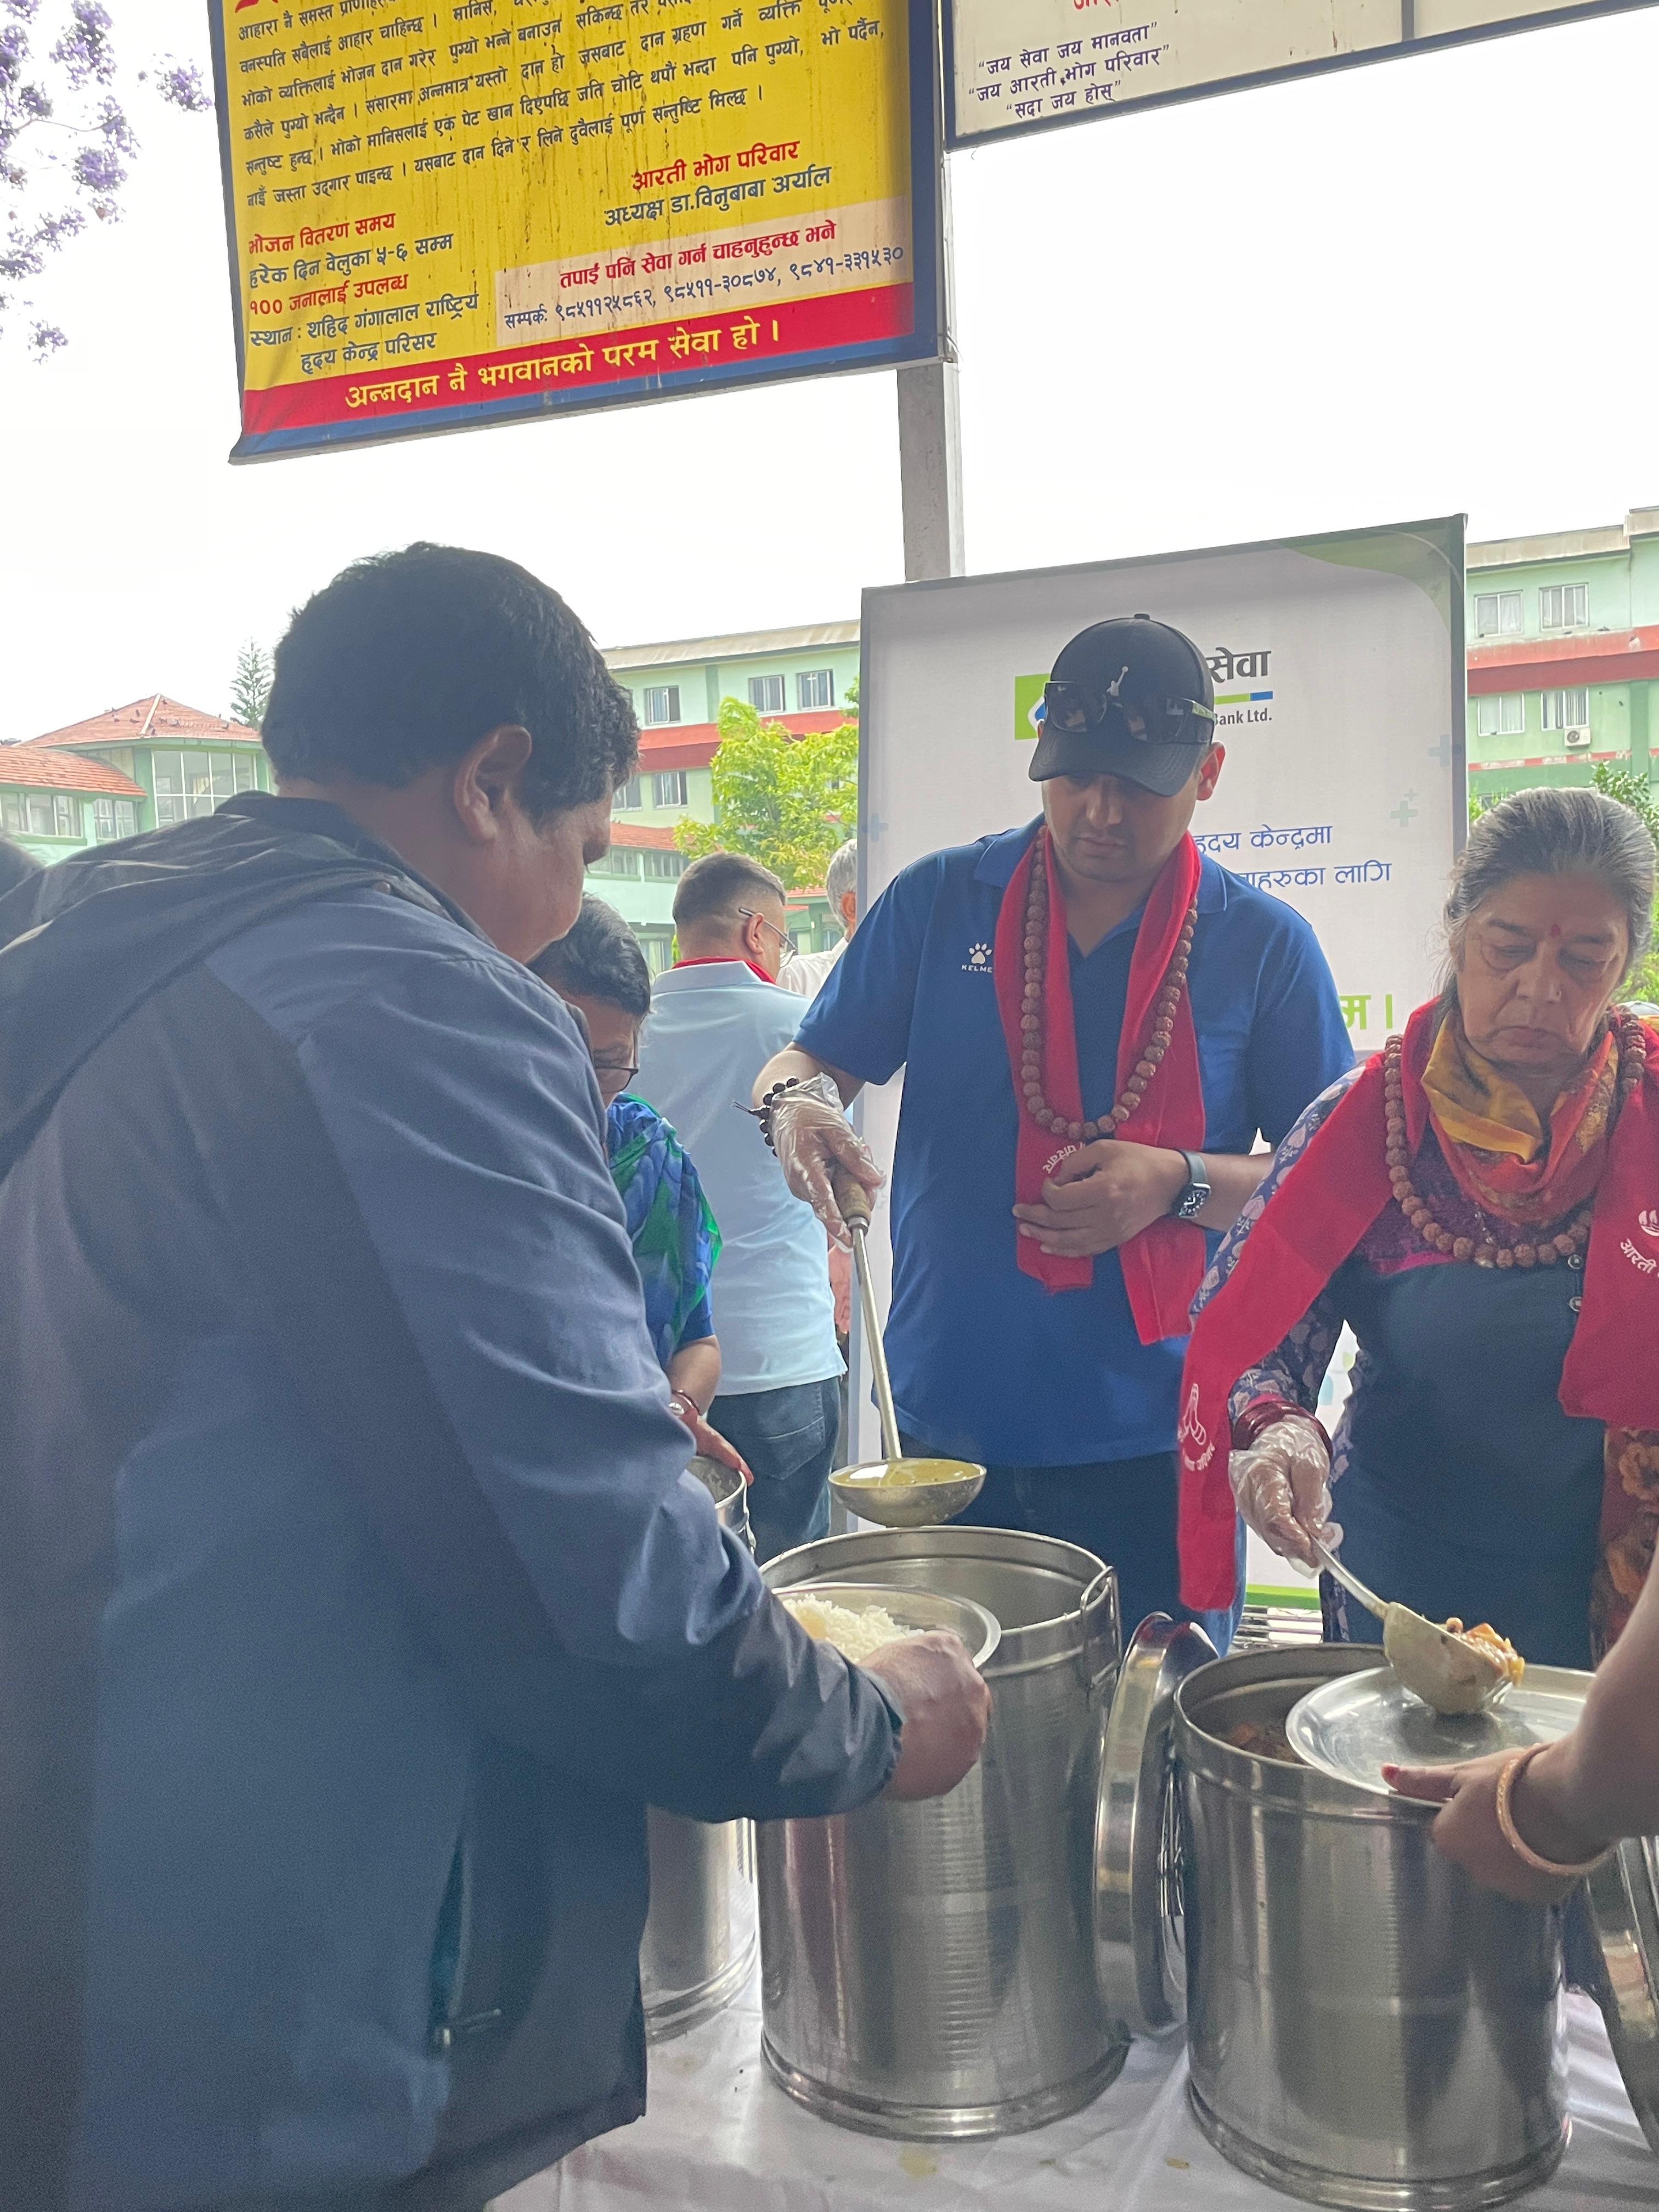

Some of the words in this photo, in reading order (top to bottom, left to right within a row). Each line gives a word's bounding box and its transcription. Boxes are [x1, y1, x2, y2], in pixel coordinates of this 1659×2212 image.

[283, 10, 293, 28] नै
[298, 4, 334, 26] समस्त
[240, 48, 286, 73] वनस्पति
[292, 35, 332, 64] सबैलाई
[338, 29, 374, 51] आहार
[379, 17, 424, 38] चाहिन्छ
[242, 86, 273, 106] भोको
[279, 70, 335, 98] व्यक्तिलाई
[341, 64, 375, 83] भोजन
[381, 58, 403, 76] दान
[409, 49, 436, 68] गरेर
[449, 37, 479, 64] पुग्यो
[485, 29, 511, 48] भन्ने
[576, 4, 623, 29] सकिन्छ
[630, 0, 649, 15] तर
[1019, 48, 1049, 69] सेवा
[1057, 40, 1083, 59] जय
[244, 119, 274, 140] कसैले
[280, 113, 308, 138] पुग्यो
[314, 103, 345, 125] भन्दैन
[475, 66, 507, 87] यस्तो
[521, 60, 545, 80] दान
[551, 52, 565, 73] हो
[640, 31, 665, 51] दान
[672, 21, 707, 44] ग्रहण
[721, 8, 743, 30] गर्ने
[1009, 67, 1056, 94] आरती
[1062, 62, 1096, 81] भोग
[246, 155, 283, 176] सन्तुष्ट
[290, 149, 313, 172] हुन्छ
[331, 135, 362, 155] भोको
[366, 118, 428, 147] मानिसलाई
[462, 110, 481, 126] पेट
[487, 103, 514, 121] खान
[576, 79, 605, 101] जति
[611, 70, 644, 92] चोटि
[683, 57, 716, 76] भन्दा
[731, 44, 759, 65] पनि
[765, 36, 804, 65] पुग्यो,
[821, 26, 840, 46] भो
[1051, 91, 1076, 110] जय
[273, 185, 306, 203] जस्ता
[356, 165, 394, 185] पाइन्छ
[414, 151, 457, 172] यसबाट
[462, 146, 486, 164] दान
[492, 137, 515, 157] दिने
[520, 136, 531, 153] र
[537, 126, 564, 147] लिने
[620, 106, 646, 133] पूर्ण
[709, 89, 748, 110] मिल्छ
[632, 160, 686, 192] आरती
[693, 154, 730, 178] भोग
[737, 140, 800, 170] परिवार
[604, 198, 664, 226] अध्यक्ष
[772, 164, 832, 193] अर्याल
[249, 234, 295, 255] भोजन
[300, 223, 349, 248] वितरण
[354, 213, 396, 235] समय
[605, 256, 636, 279] पनि
[641, 252, 673, 274] सेवा
[678, 242, 707, 266] गर्न
[712, 229, 800, 260] चाहनुहुन्छ
[805, 219, 837, 243] भने
[250, 263, 289, 289] हरेक
[294, 259, 321, 280] दिन
[414, 234, 454, 255] सम्म
[250, 298, 283, 315] १००
[289, 280, 348, 311] जनालाई
[354, 274, 409, 298] उपलब्ध
[250, 326, 293, 347] स्थान
[307, 314, 349, 339] शहिद
[354, 303, 420, 330] गंगालाल
[301, 348, 337, 374] हृदय
[343, 341, 379, 362] केन्द्र
[385, 332, 437, 354] परिसर
[345, 375, 440, 409] अन्नदान
[448, 363, 468, 392] नै
[478, 343, 594, 387] भगवानको
[602, 339, 659, 366] परम
[668, 326, 721, 359] सेवा
[730, 315, 760, 351] हो
[1247, 708, 1272, 723] Ltd.
[1250, 824, 1333, 850] केन्द्रमा
[1334, 860, 1392, 883] लागि
[961, 964, 992, 973] KELME
[1620, 1238, 1657, 1273] आरती
